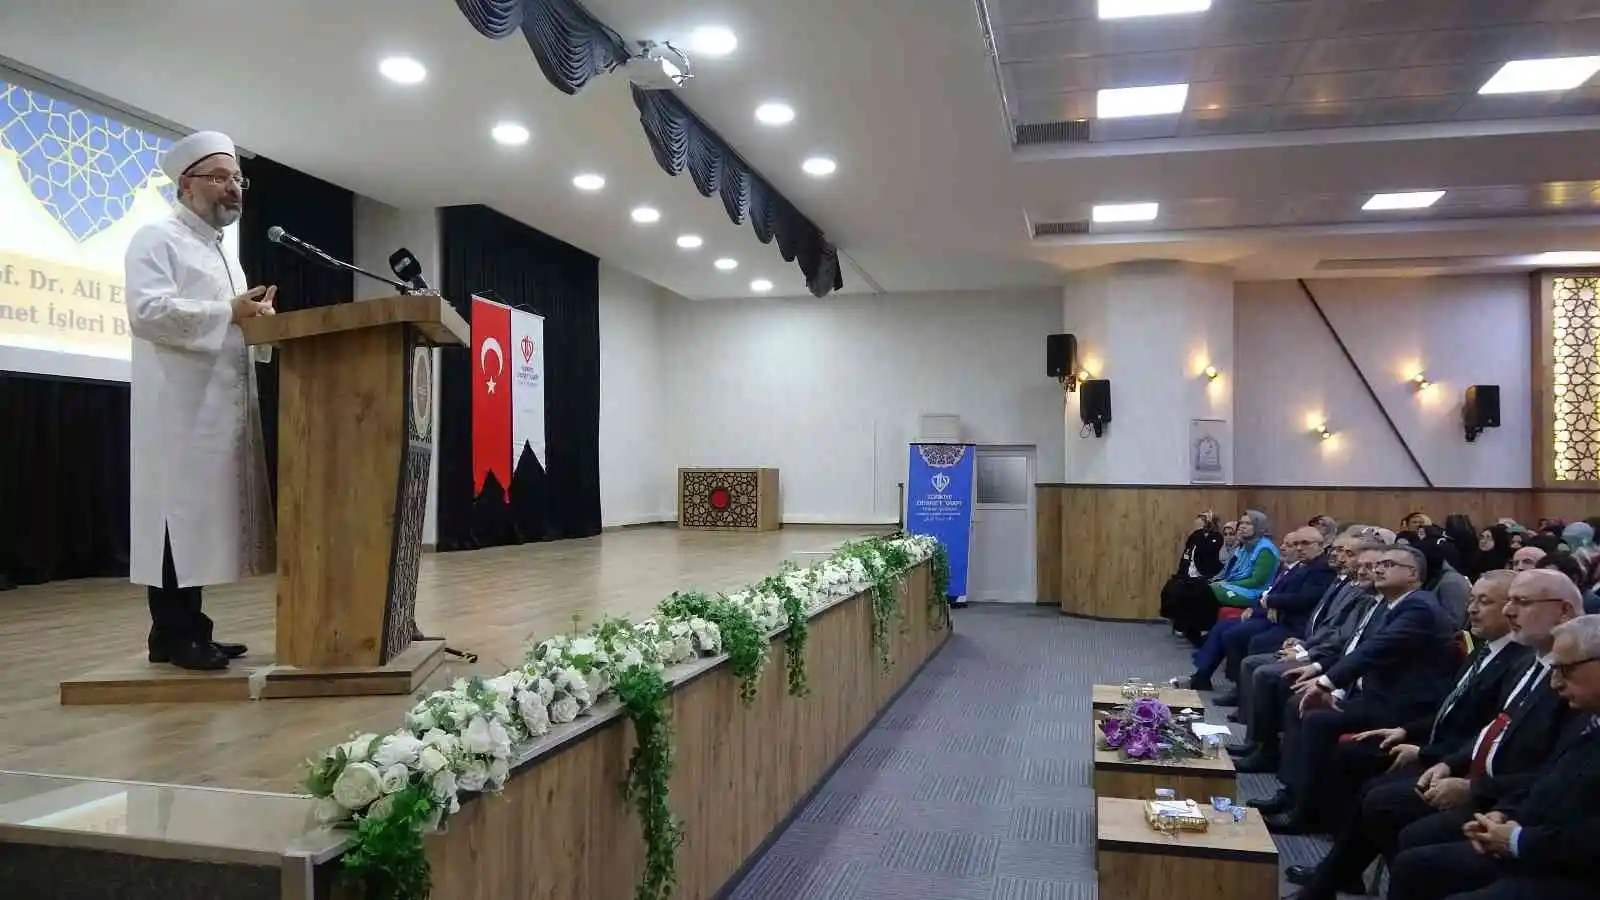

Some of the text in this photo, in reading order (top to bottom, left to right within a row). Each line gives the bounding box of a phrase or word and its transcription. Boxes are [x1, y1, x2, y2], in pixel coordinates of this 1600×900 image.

[0, 264, 126, 304] f. Dr. Ali E
[46, 302, 105, 335] İşleri
[111, 316, 132, 336] B
